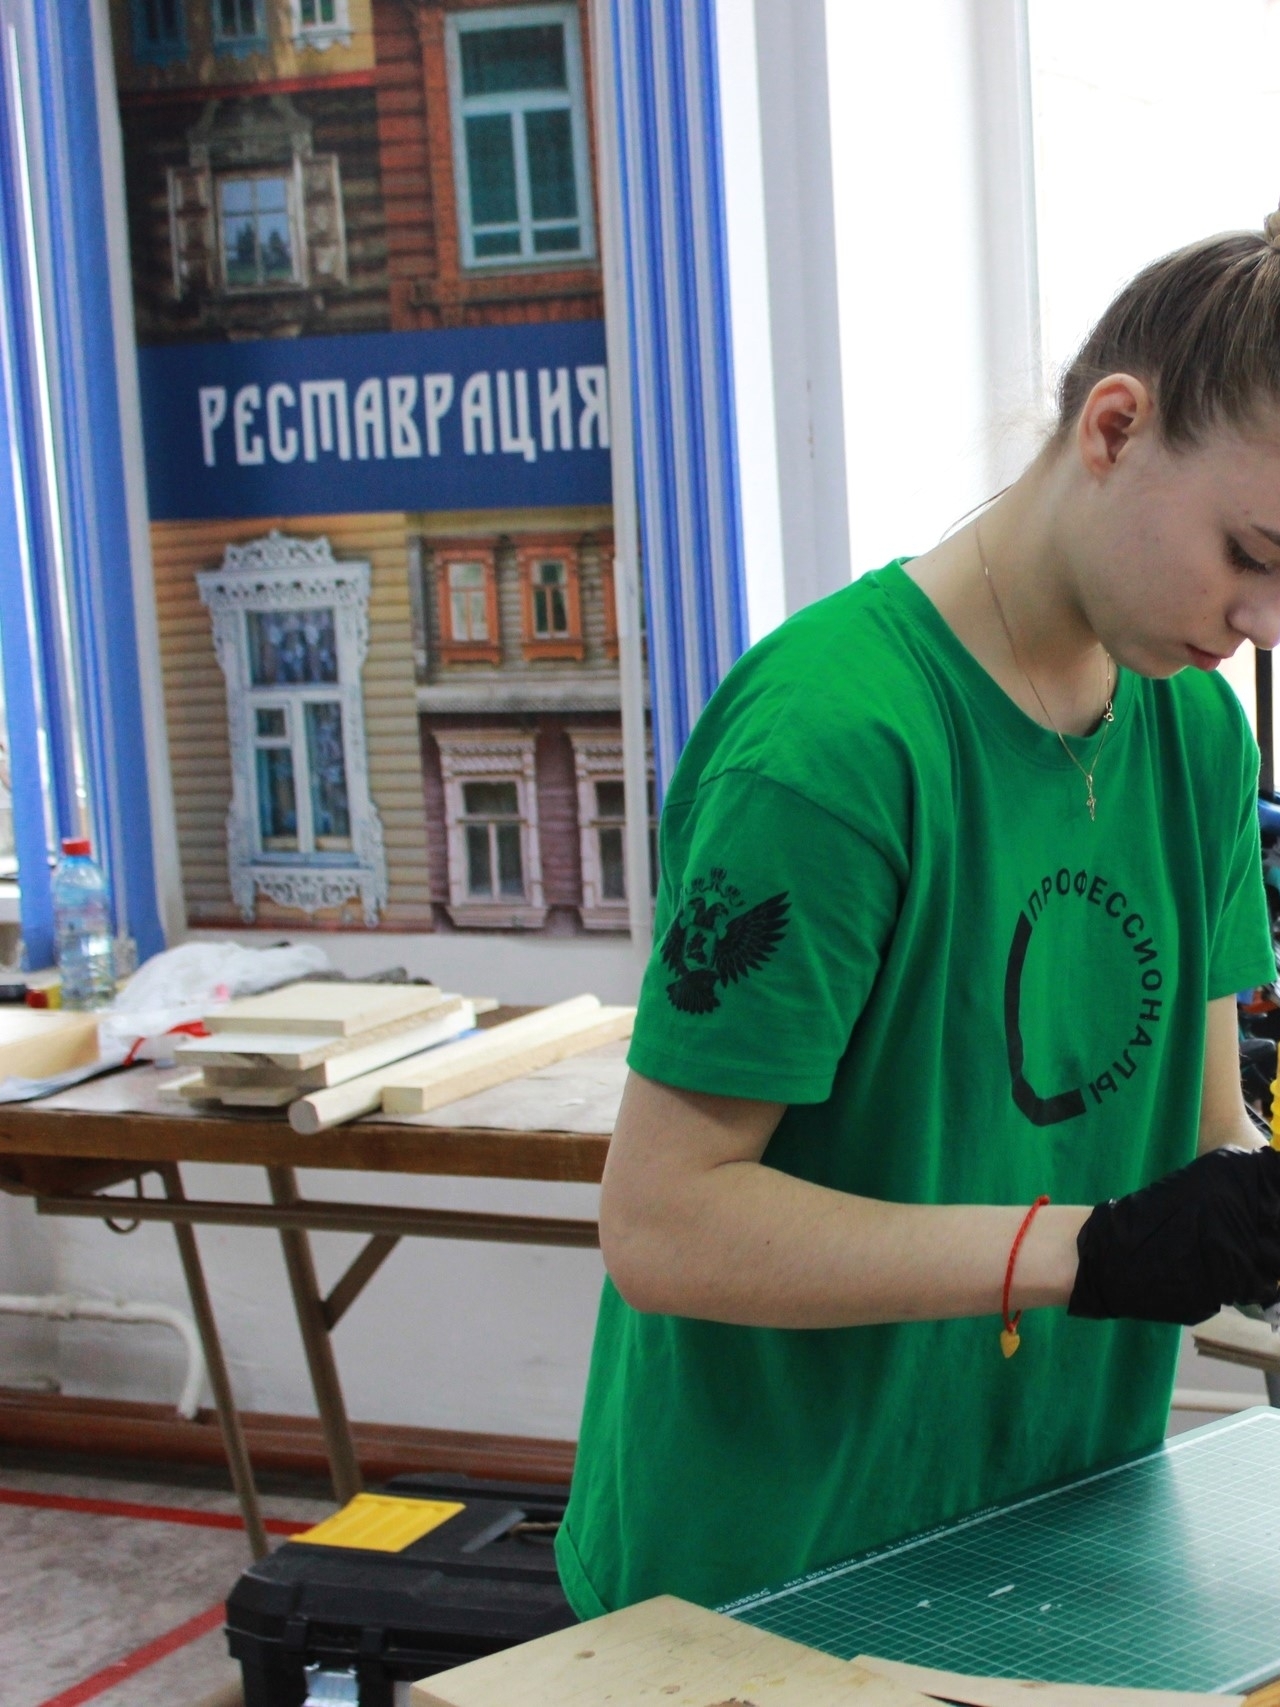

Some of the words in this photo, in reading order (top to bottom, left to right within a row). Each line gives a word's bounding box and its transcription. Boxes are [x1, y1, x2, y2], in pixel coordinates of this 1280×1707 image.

[199, 364, 610, 467] РЕСТАВРАЦИЯ
[1027, 867, 1163, 1105] ПРОФЕССИОНАЛЫ
[714, 1588, 771, 1613] RAUBERG
